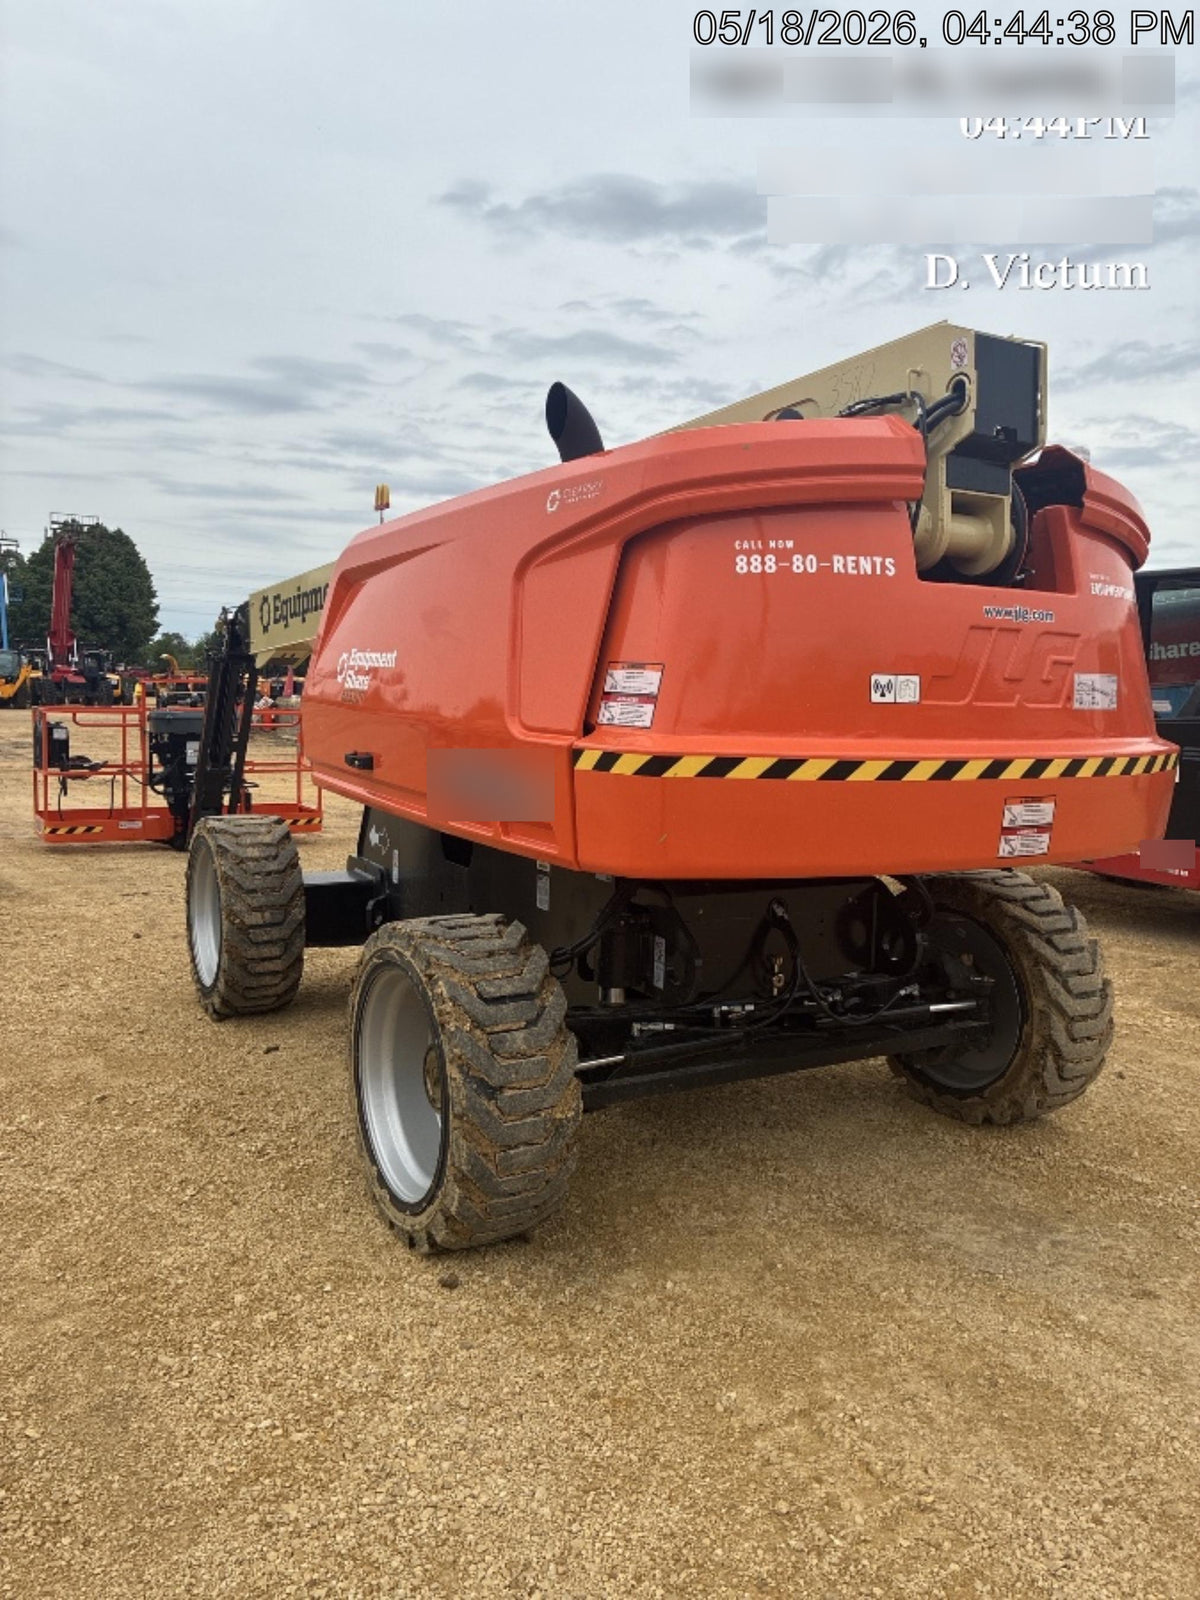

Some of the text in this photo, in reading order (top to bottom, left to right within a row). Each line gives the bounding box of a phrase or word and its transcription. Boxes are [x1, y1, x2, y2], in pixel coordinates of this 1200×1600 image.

[734, 540, 795, 550] CALL NOW
[735, 554, 896, 577] 888-80-RENTS
[983, 605, 1055, 623] www.jlg.com
[1150, 640, 1200, 660] hare
